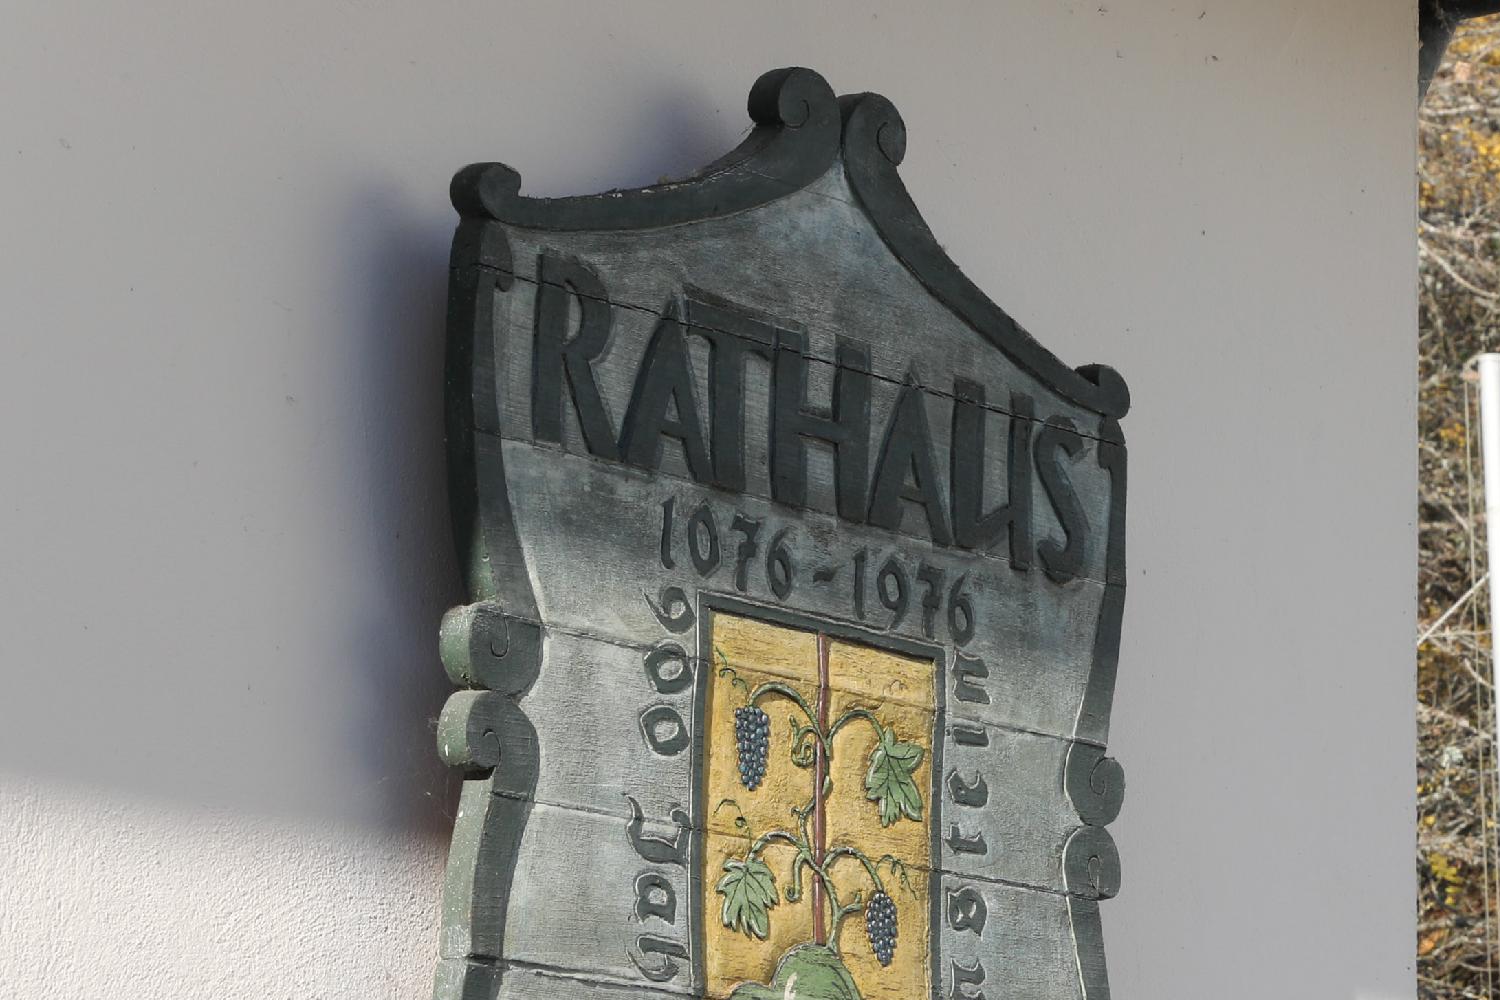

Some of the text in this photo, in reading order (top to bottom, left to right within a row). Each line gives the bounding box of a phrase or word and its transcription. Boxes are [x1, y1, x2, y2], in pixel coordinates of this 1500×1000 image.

[531, 252, 1092, 585] RATHAUS
[660, 500, 978, 648] 1076-1976
[639, 585, 696, 756] 900
